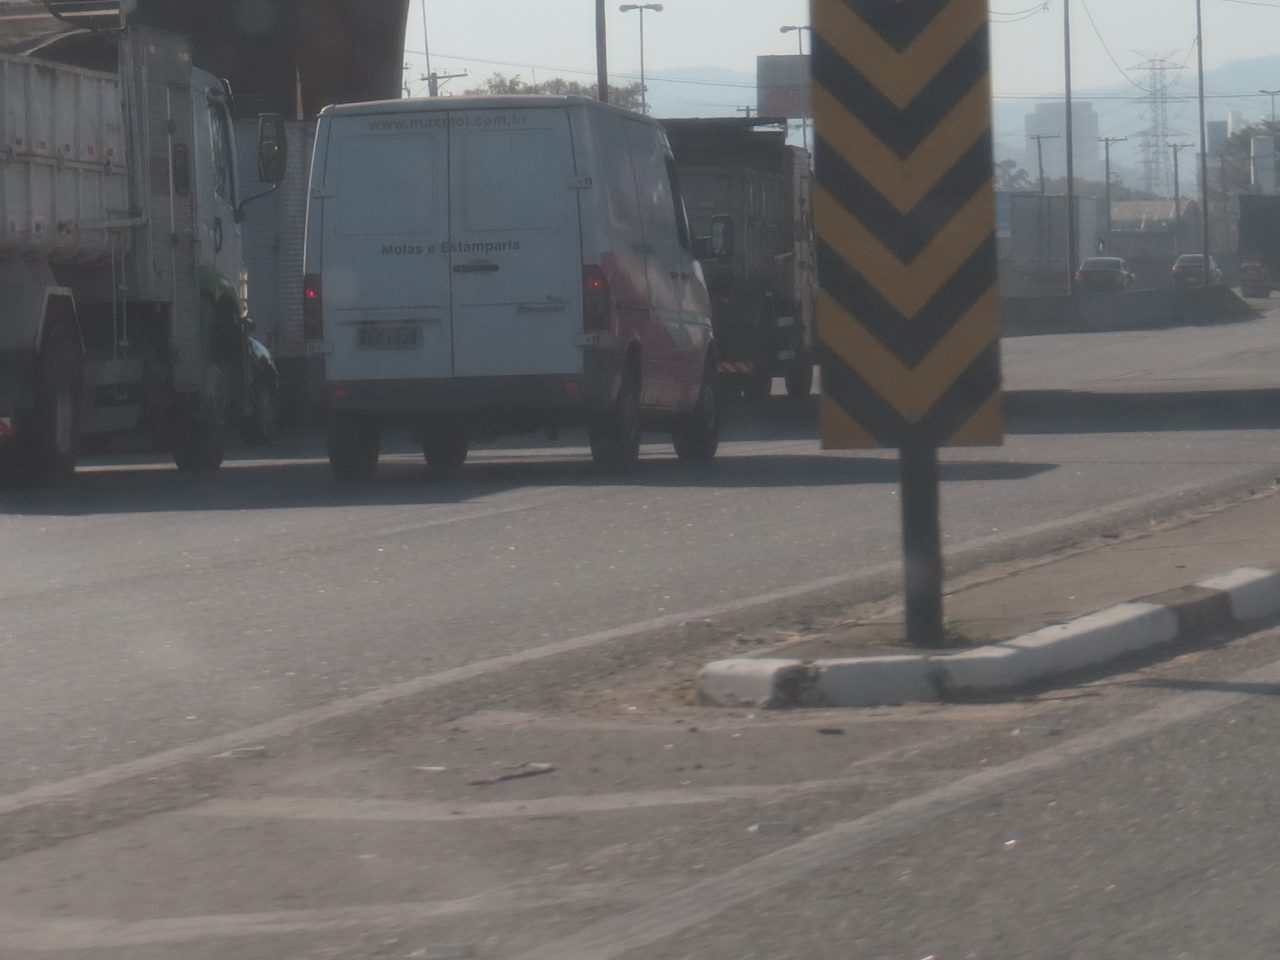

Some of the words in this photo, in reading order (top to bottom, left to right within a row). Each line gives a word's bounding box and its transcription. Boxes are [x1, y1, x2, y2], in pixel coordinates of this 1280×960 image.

[381, 243, 423, 256] Molas
[428, 245, 436, 254] e
[440, 239, 521, 254] Estamparia
